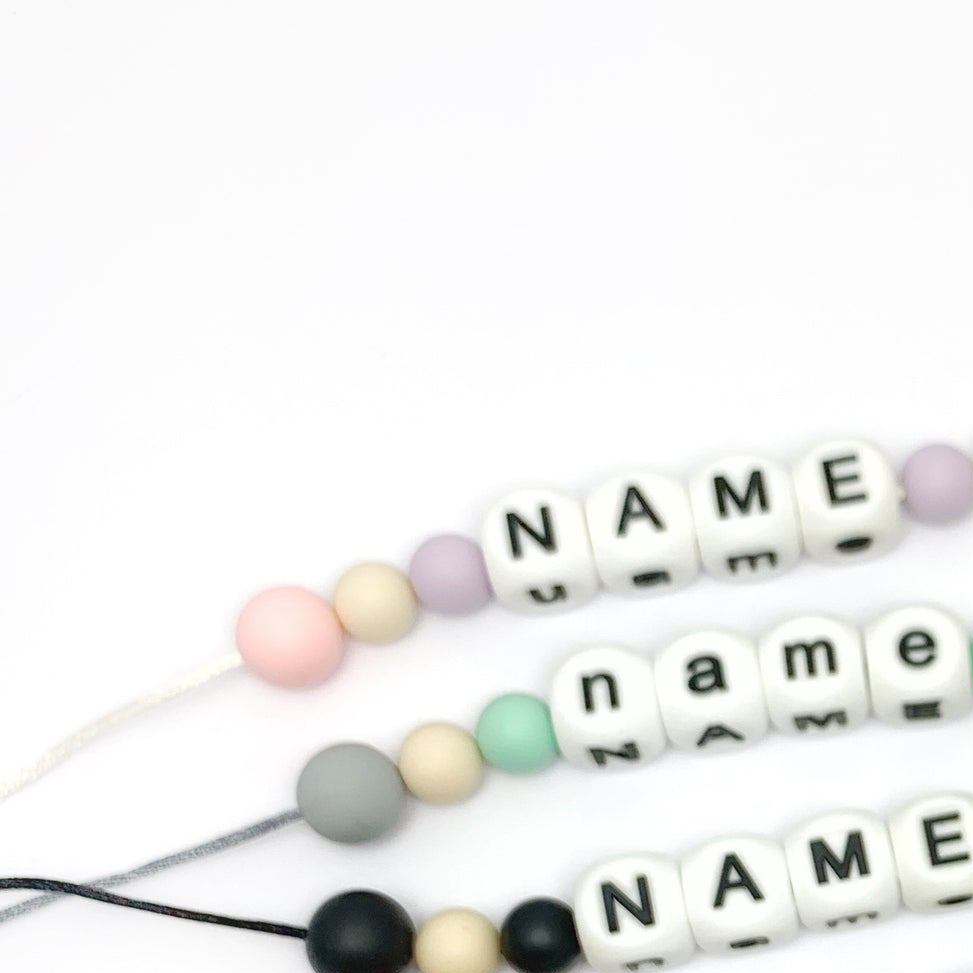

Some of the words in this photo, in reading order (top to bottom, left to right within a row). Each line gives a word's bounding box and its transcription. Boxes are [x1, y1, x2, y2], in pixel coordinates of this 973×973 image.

[506, 455, 866, 558] NAME
[581, 630, 937, 712] name
[600, 811, 970, 934] NAME
